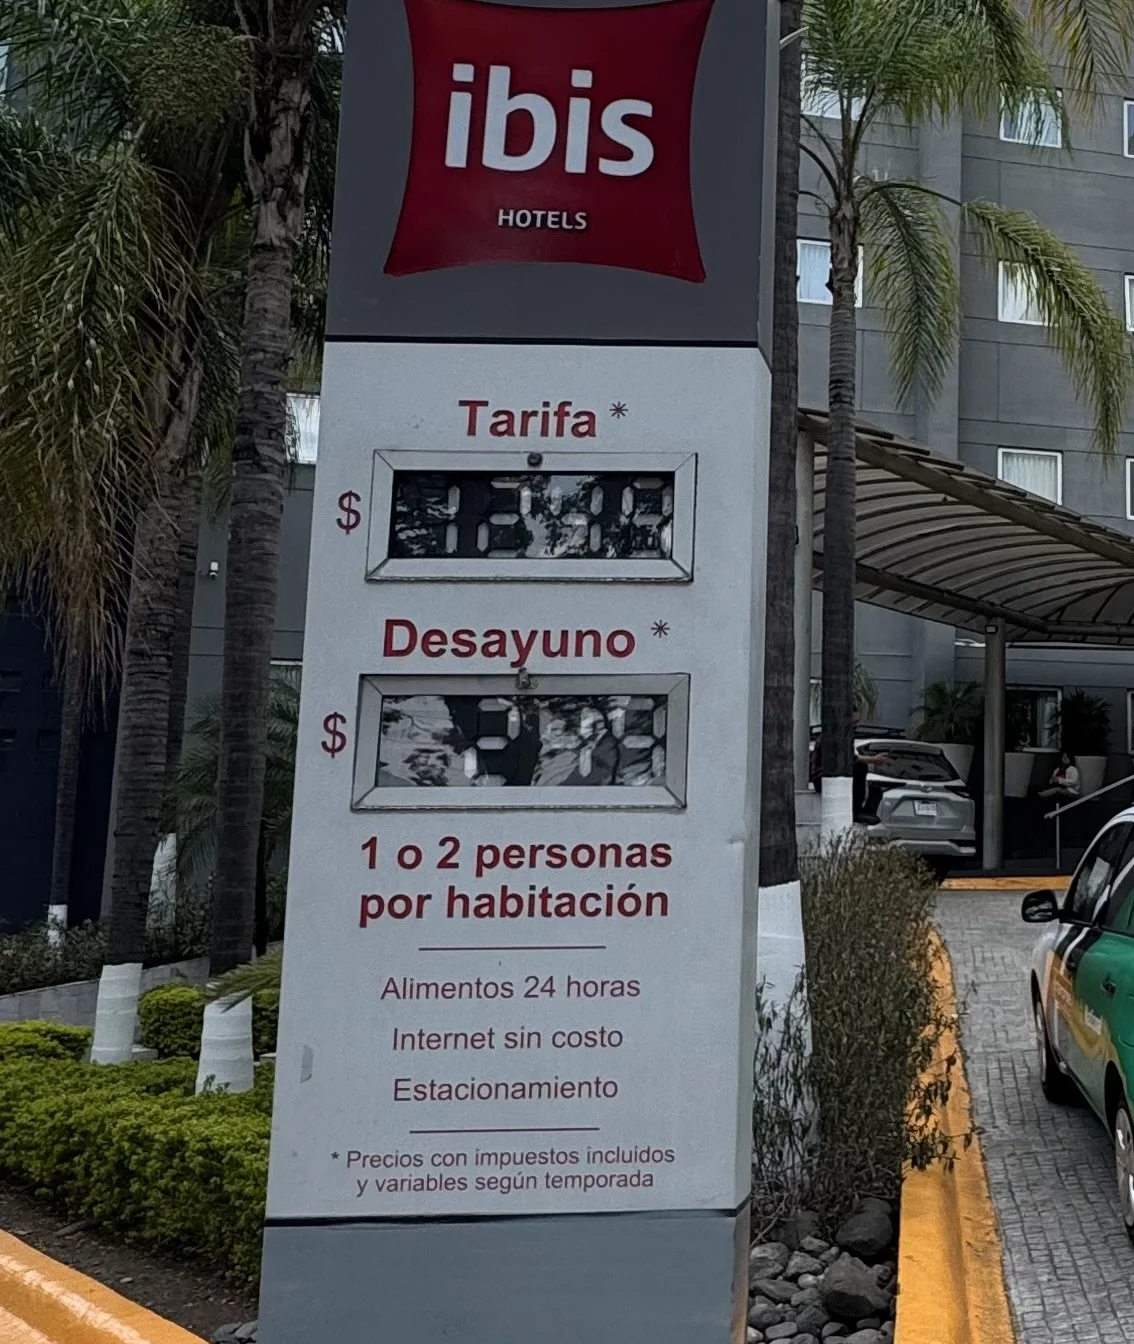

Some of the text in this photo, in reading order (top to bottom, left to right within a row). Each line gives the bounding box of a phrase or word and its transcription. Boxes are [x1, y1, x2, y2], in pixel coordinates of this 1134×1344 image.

[444, 63, 654, 176] ibis
[498, 209, 588, 230] HOTELS
[459, 400, 597, 438] Tarifa
[336, 491, 361, 534] $
[383, 619, 636, 668] Desayuno
[321, 712, 347, 757] $
[361, 837, 673, 877] 1 o 2 personas
[359, 884, 670, 928] por habitación
[380, 976, 641, 1000] Alimentos 24 horas
[393, 1026, 624, 1051] Internet sin costo
[394, 1077, 619, 1102] Estacionamiento
[346, 1150, 424, 1169] Precios
[430, 1151, 468, 1167] con
[474, 1147, 580, 1170] impuestos
[355, 1170, 655, 1197] y variables según temporada
